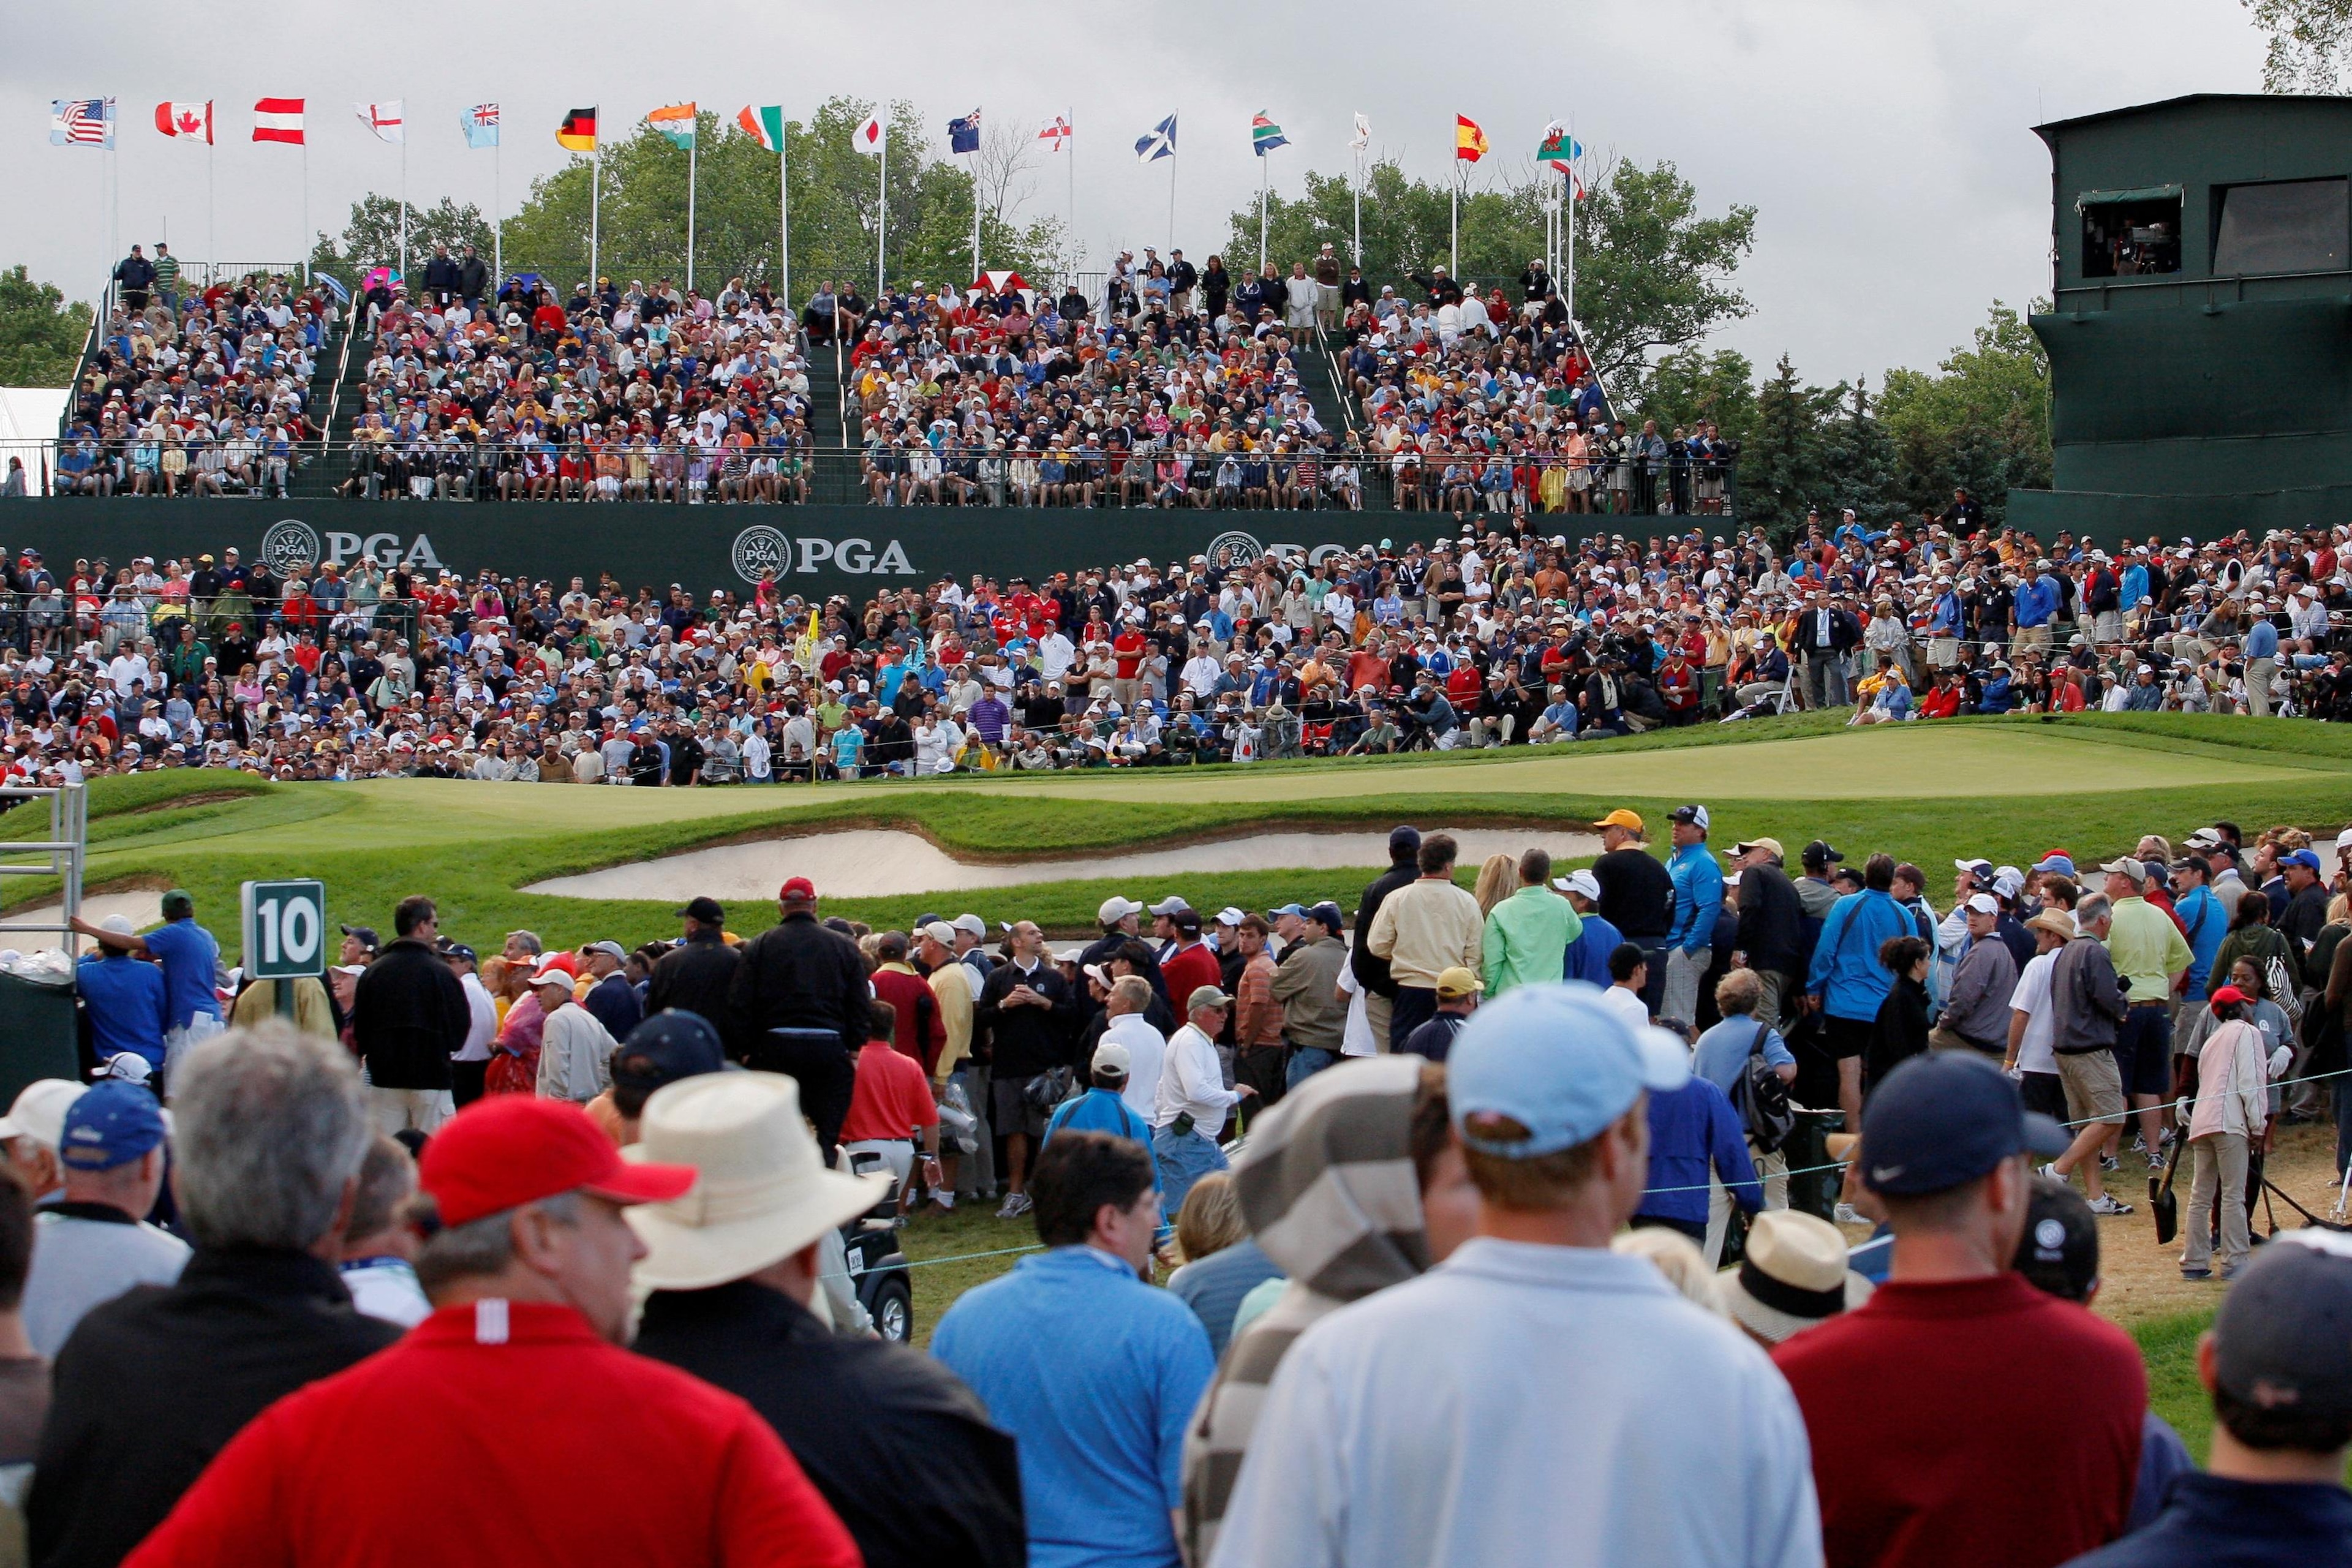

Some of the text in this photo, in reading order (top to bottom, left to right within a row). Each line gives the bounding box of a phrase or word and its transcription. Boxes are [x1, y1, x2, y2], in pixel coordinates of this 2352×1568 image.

[274, 545, 308, 555] PGA
[325, 532, 443, 568] PGA
[745, 549, 779, 561] PGA
[796, 538, 917, 574] PGA
[1230, 556, 1252, 567] GA
[257, 895, 320, 963] 10
